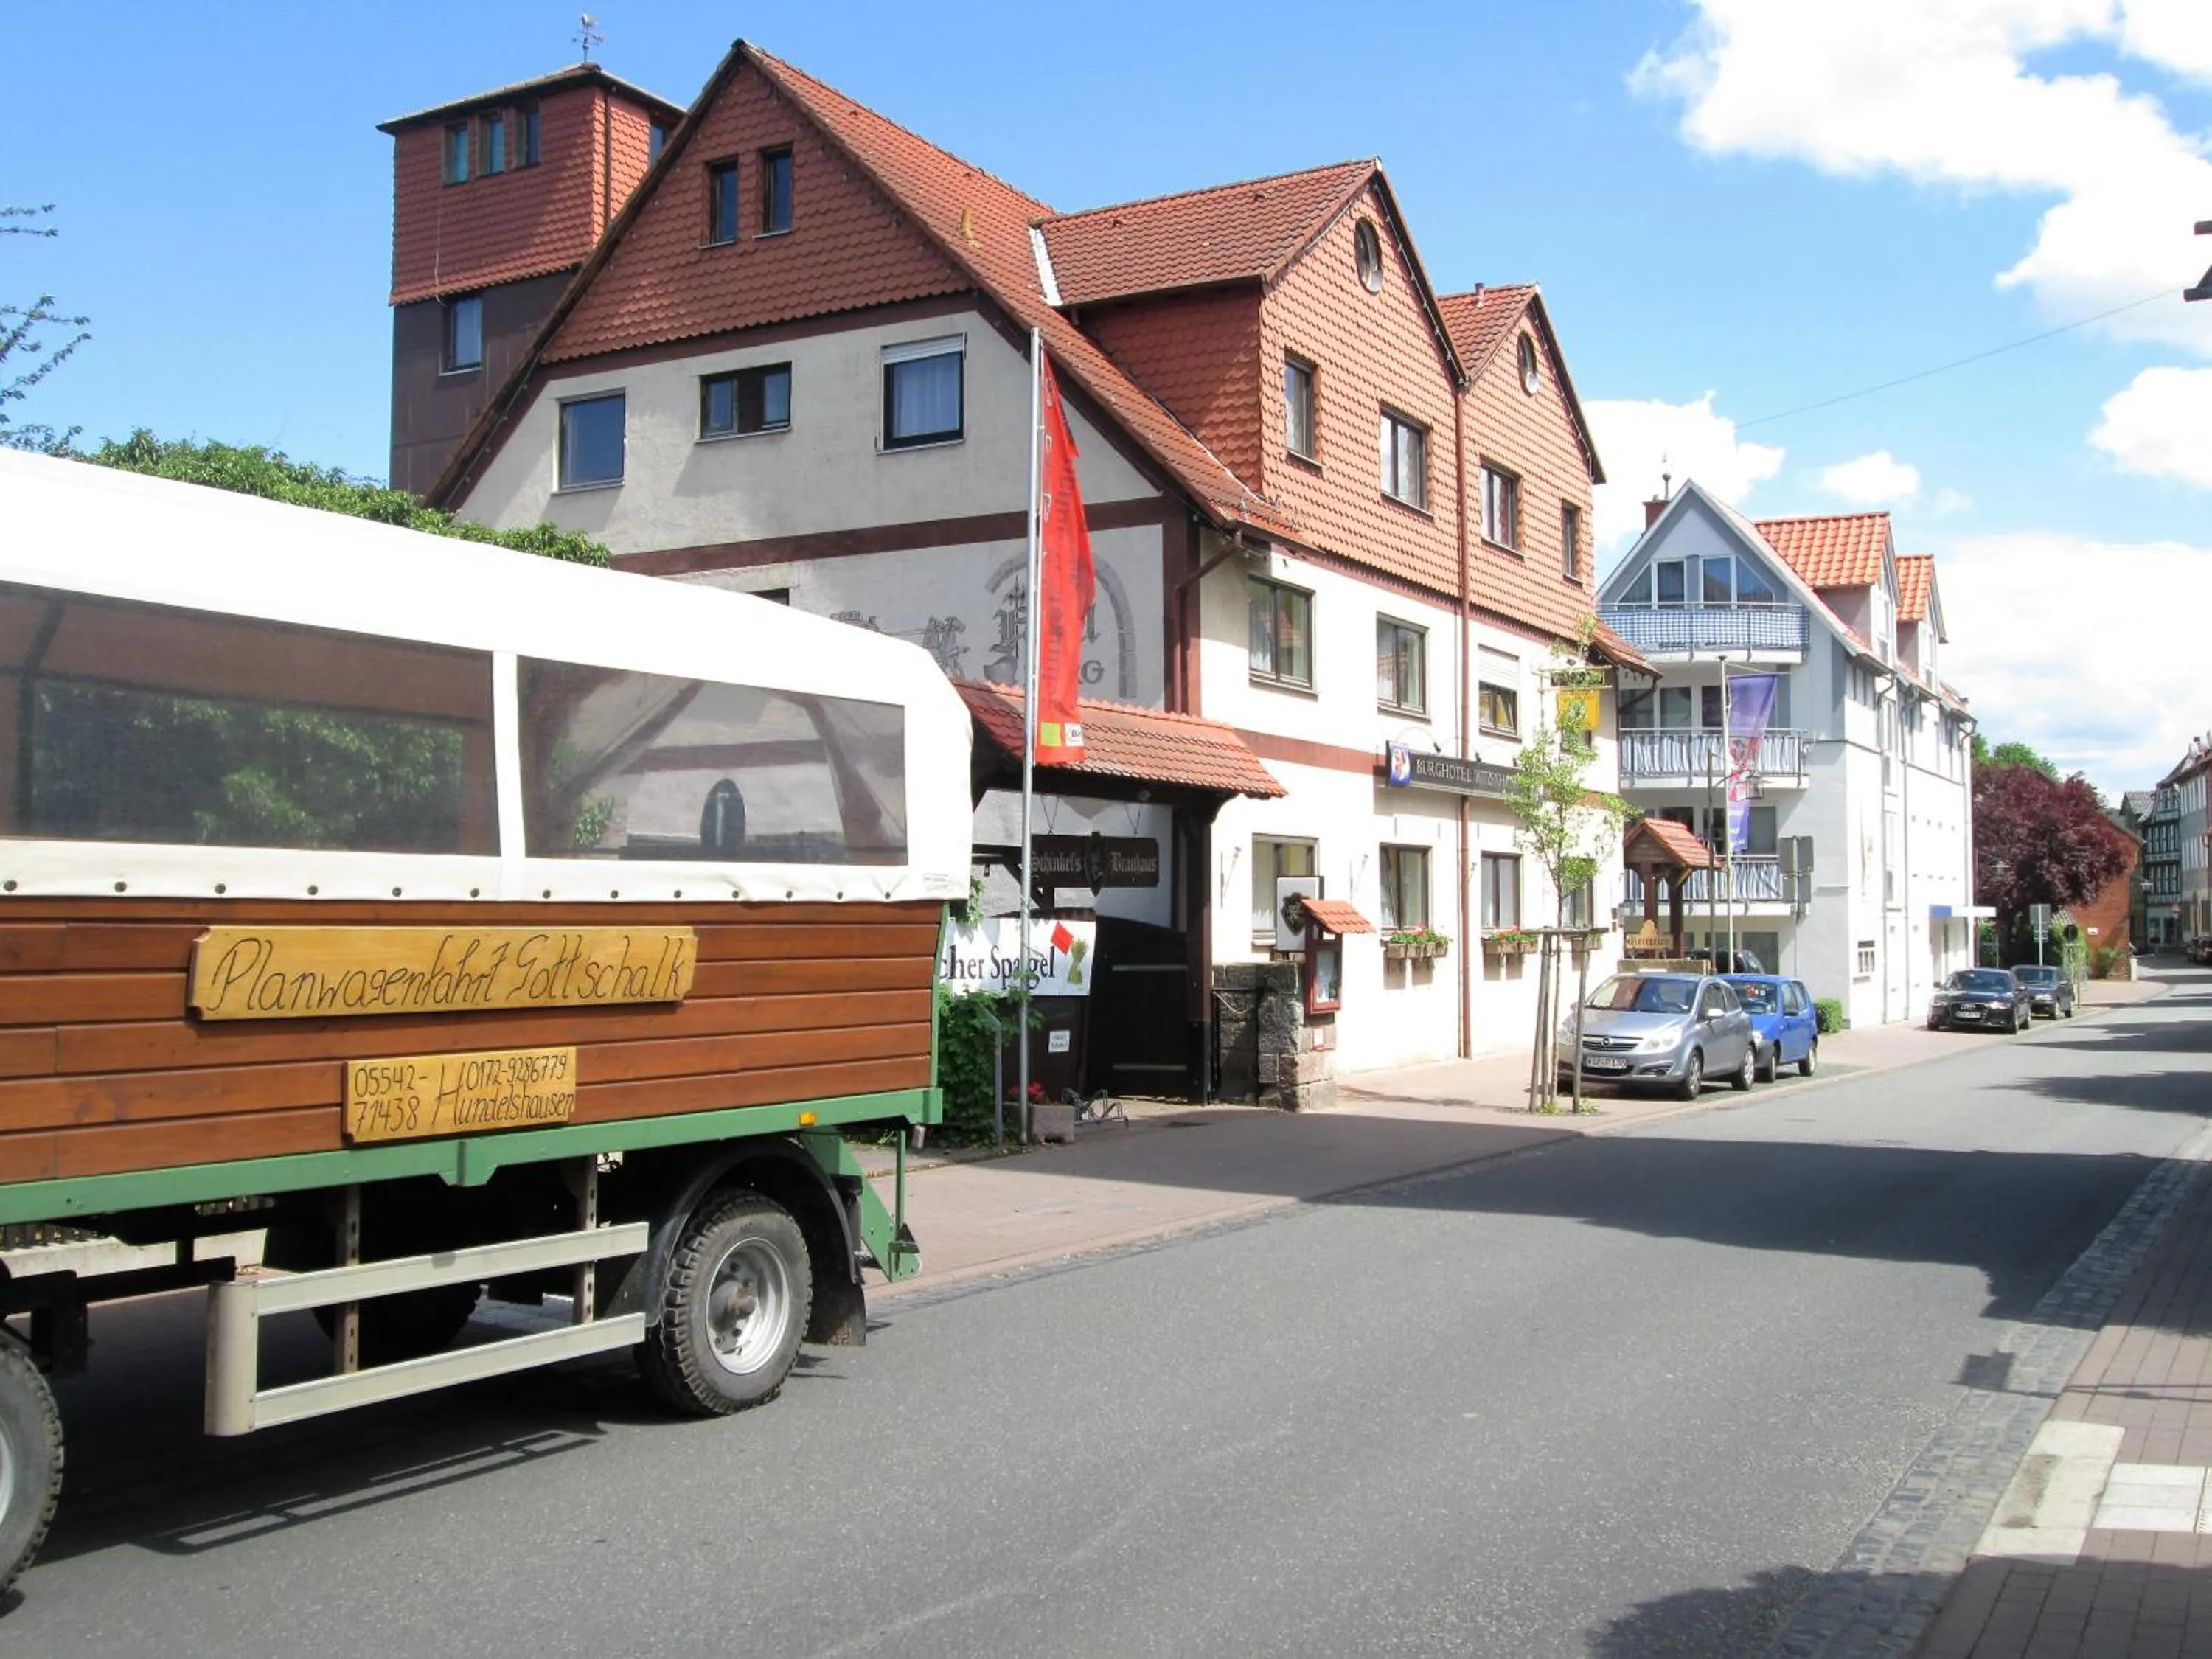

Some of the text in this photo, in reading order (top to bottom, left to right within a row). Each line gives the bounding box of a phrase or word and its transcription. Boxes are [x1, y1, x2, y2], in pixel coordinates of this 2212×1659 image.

[1416, 759, 1472, 782] BURGHOTEL
[1109, 851, 1157, 874] Brauhaus
[206, 934, 684, 1011] Planwagenfahrt Gottschalk
[990, 944, 1055, 990] Spagel
[466, 1052, 568, 1091] 0172-9286779
[354, 1096, 420, 1133] 71438
[431, 1062, 575, 1129] Hundelshausen
